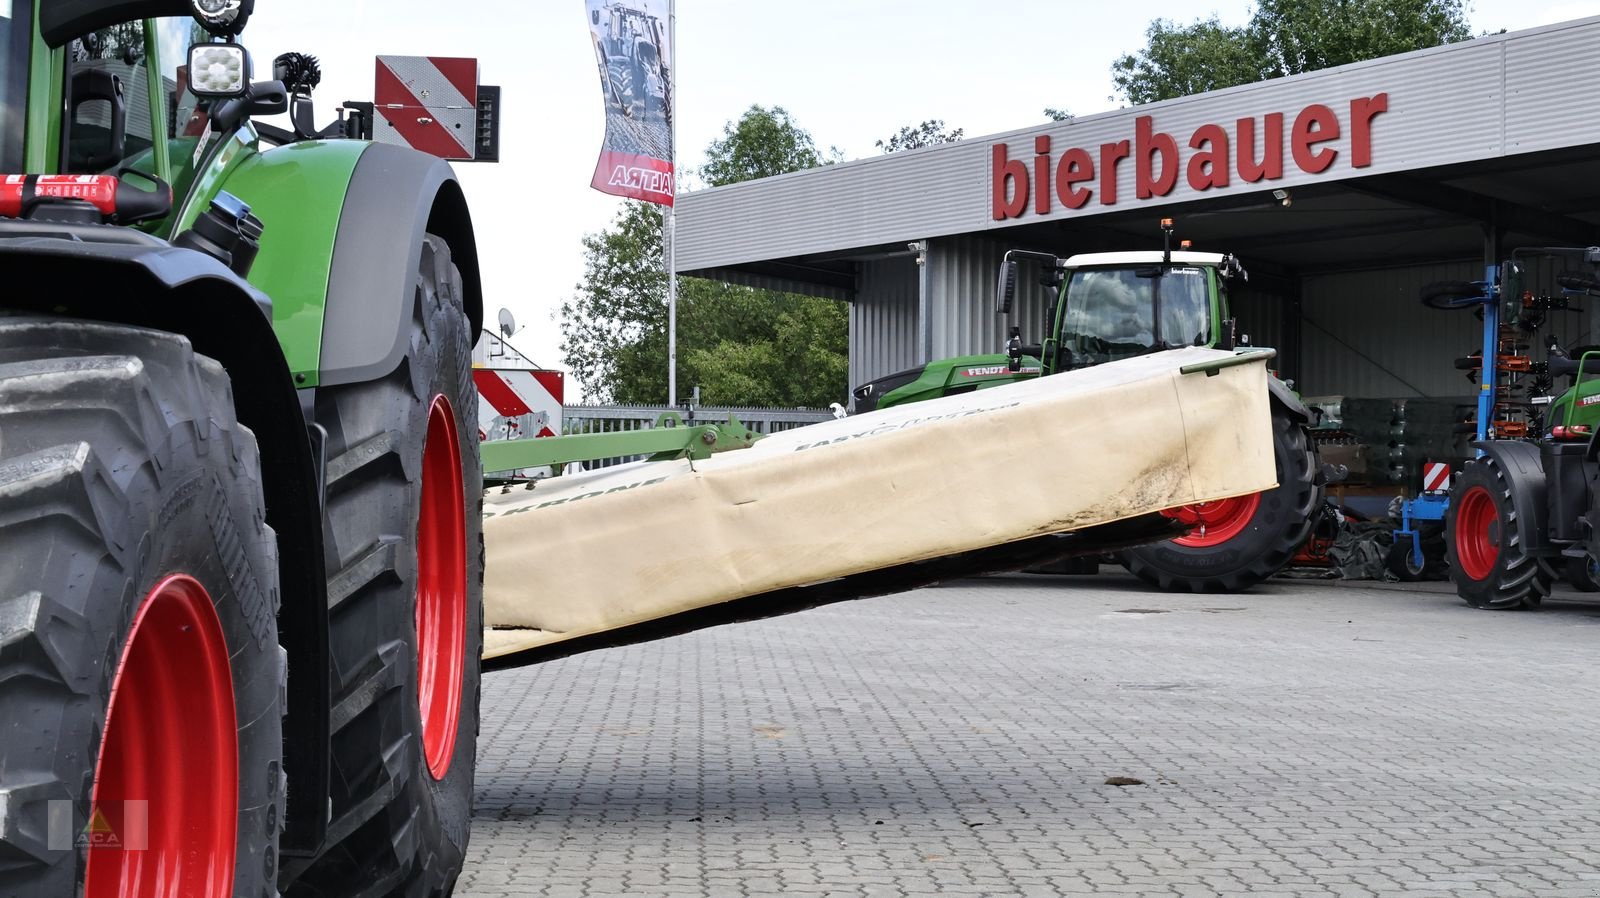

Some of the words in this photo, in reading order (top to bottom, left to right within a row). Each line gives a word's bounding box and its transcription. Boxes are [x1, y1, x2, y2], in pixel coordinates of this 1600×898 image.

[992, 92, 1388, 221] bierbauer
[967, 366, 1006, 376] FENDT
[501, 475, 670, 517] KRONE
